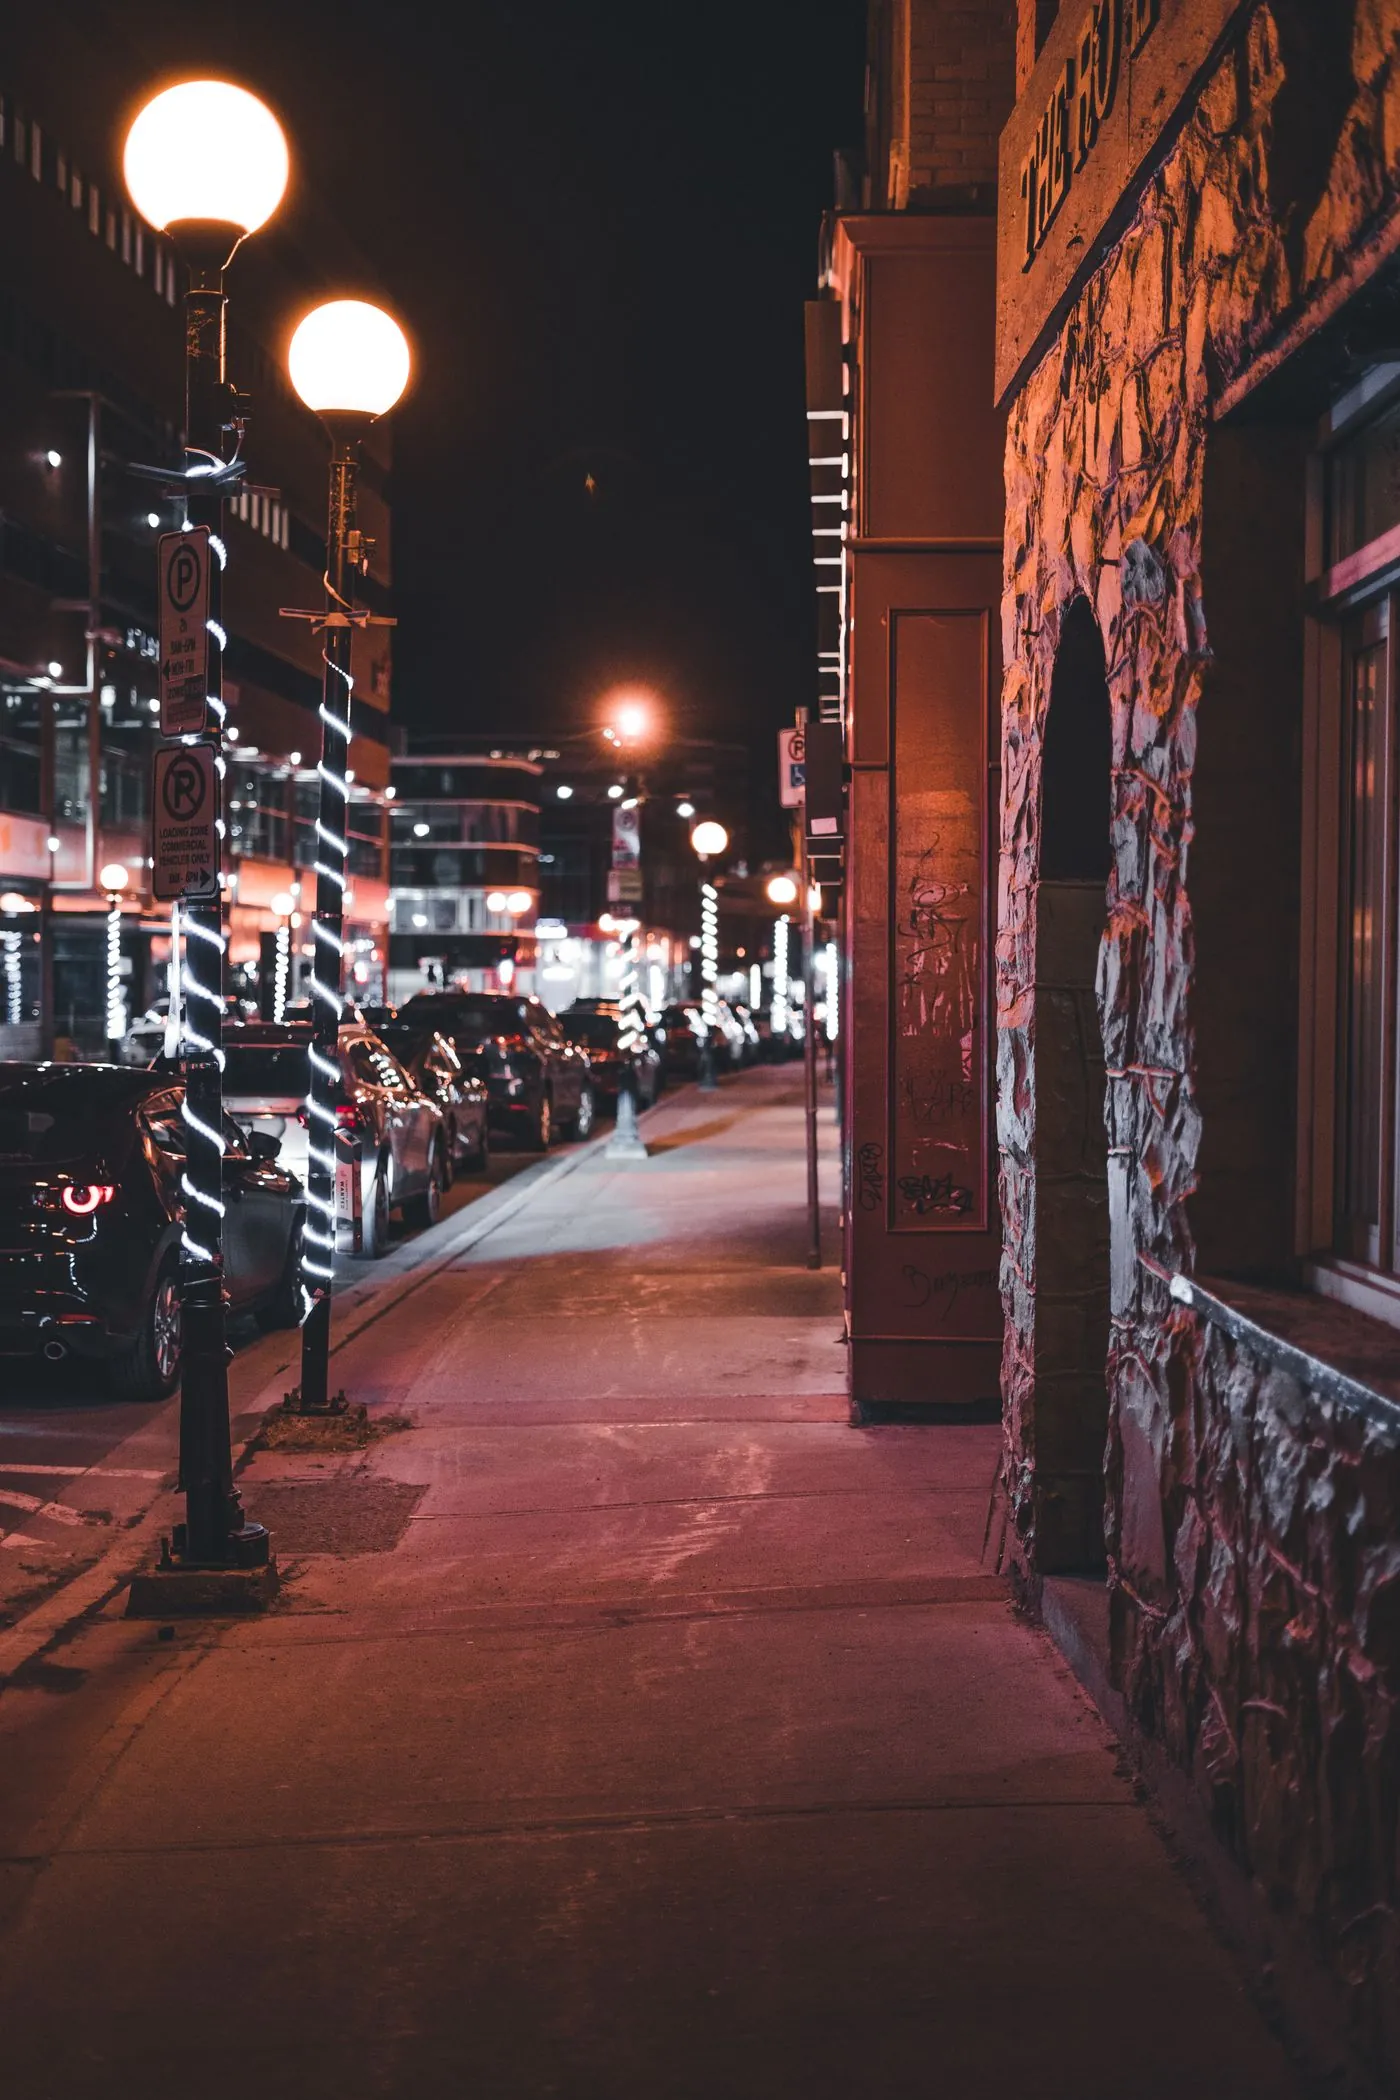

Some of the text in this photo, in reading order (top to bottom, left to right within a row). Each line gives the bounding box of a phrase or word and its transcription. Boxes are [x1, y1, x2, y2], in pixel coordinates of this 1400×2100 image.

[1020, 58, 1075, 273] THE
[177, 557, 193, 599] P
[174, 769, 196, 809] P
[159, 824, 209, 839] LOADING ZONE
[162, 840, 206, 852] COMMERCIAL
[159, 853, 210, 868] VEHICLES ONLY
